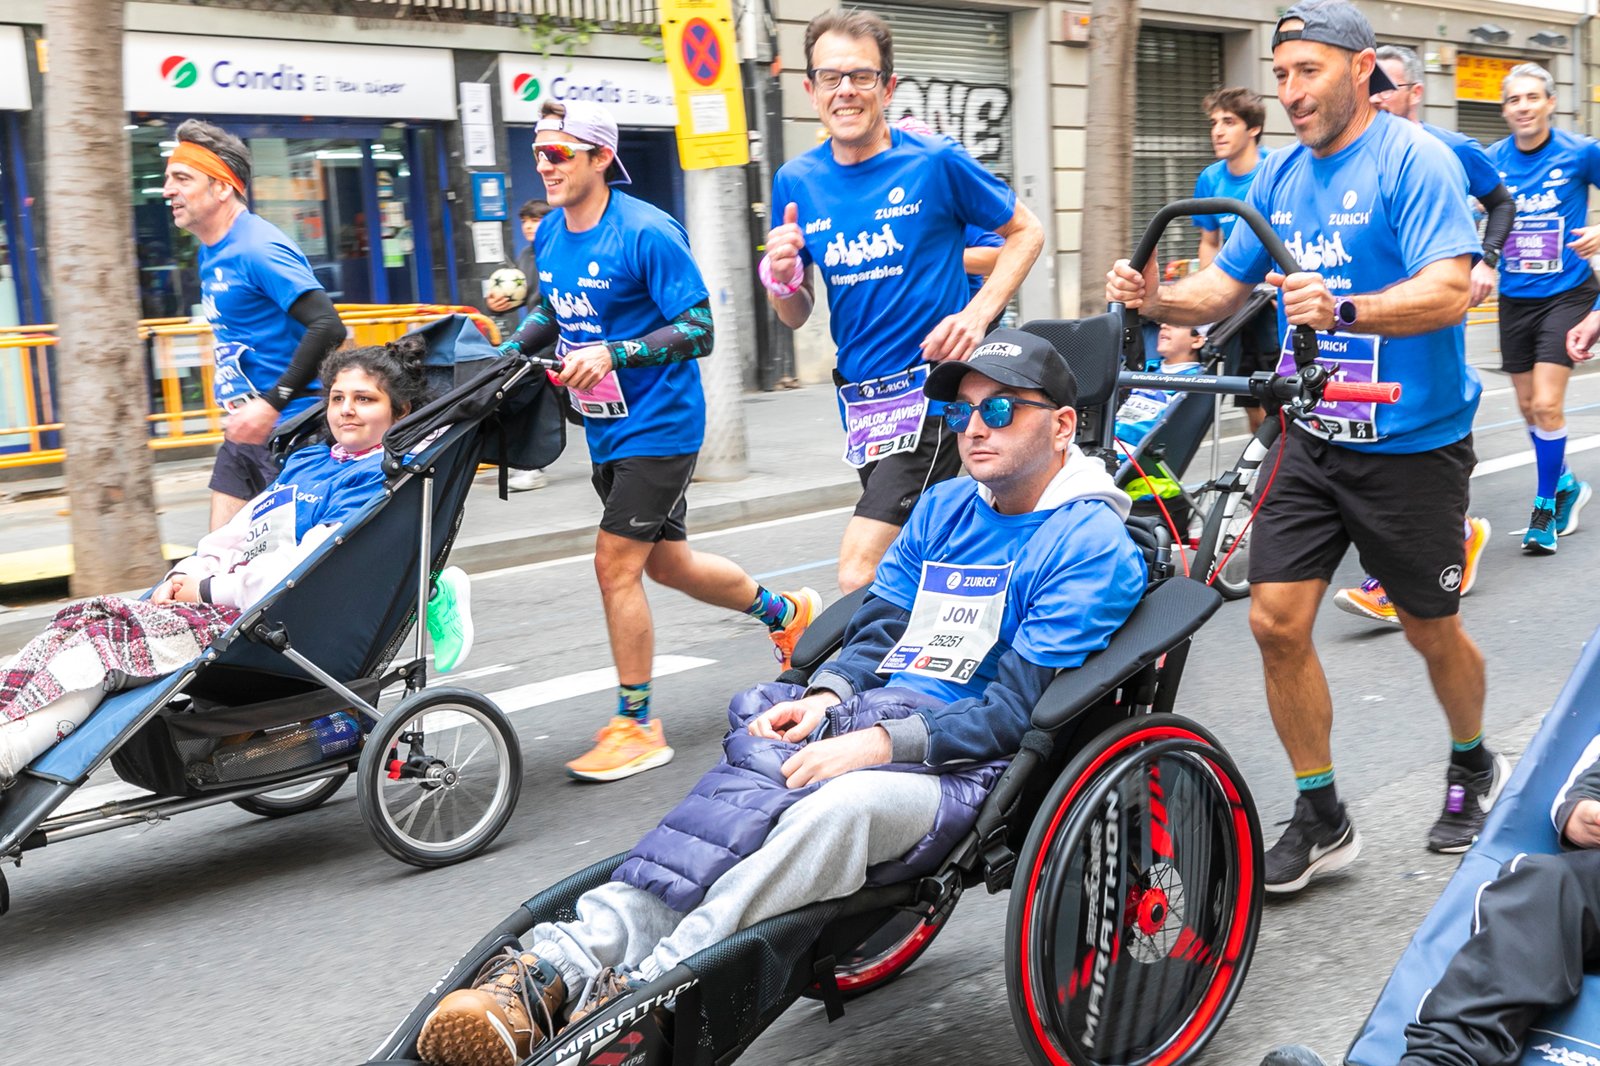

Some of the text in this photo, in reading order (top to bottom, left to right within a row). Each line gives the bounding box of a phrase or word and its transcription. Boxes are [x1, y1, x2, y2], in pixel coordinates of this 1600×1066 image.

[212, 60, 305, 91] Condis
[551, 77, 622, 103] Condis
[875, 203, 920, 220] ZURICH
[1328, 211, 1369, 225] ZURICH
[577, 277, 610, 289] ZURICH
[831, 265, 904, 286] #imparables
[1316, 339, 1347, 352] URICH
[850, 403, 924, 432] CARLOS JAVIER
[963, 576, 998, 588] ZURICH
[943, 606, 979, 624] JON
[928, 635, 964, 648] 25251
[1081, 789, 1120, 1049] MARATHON
